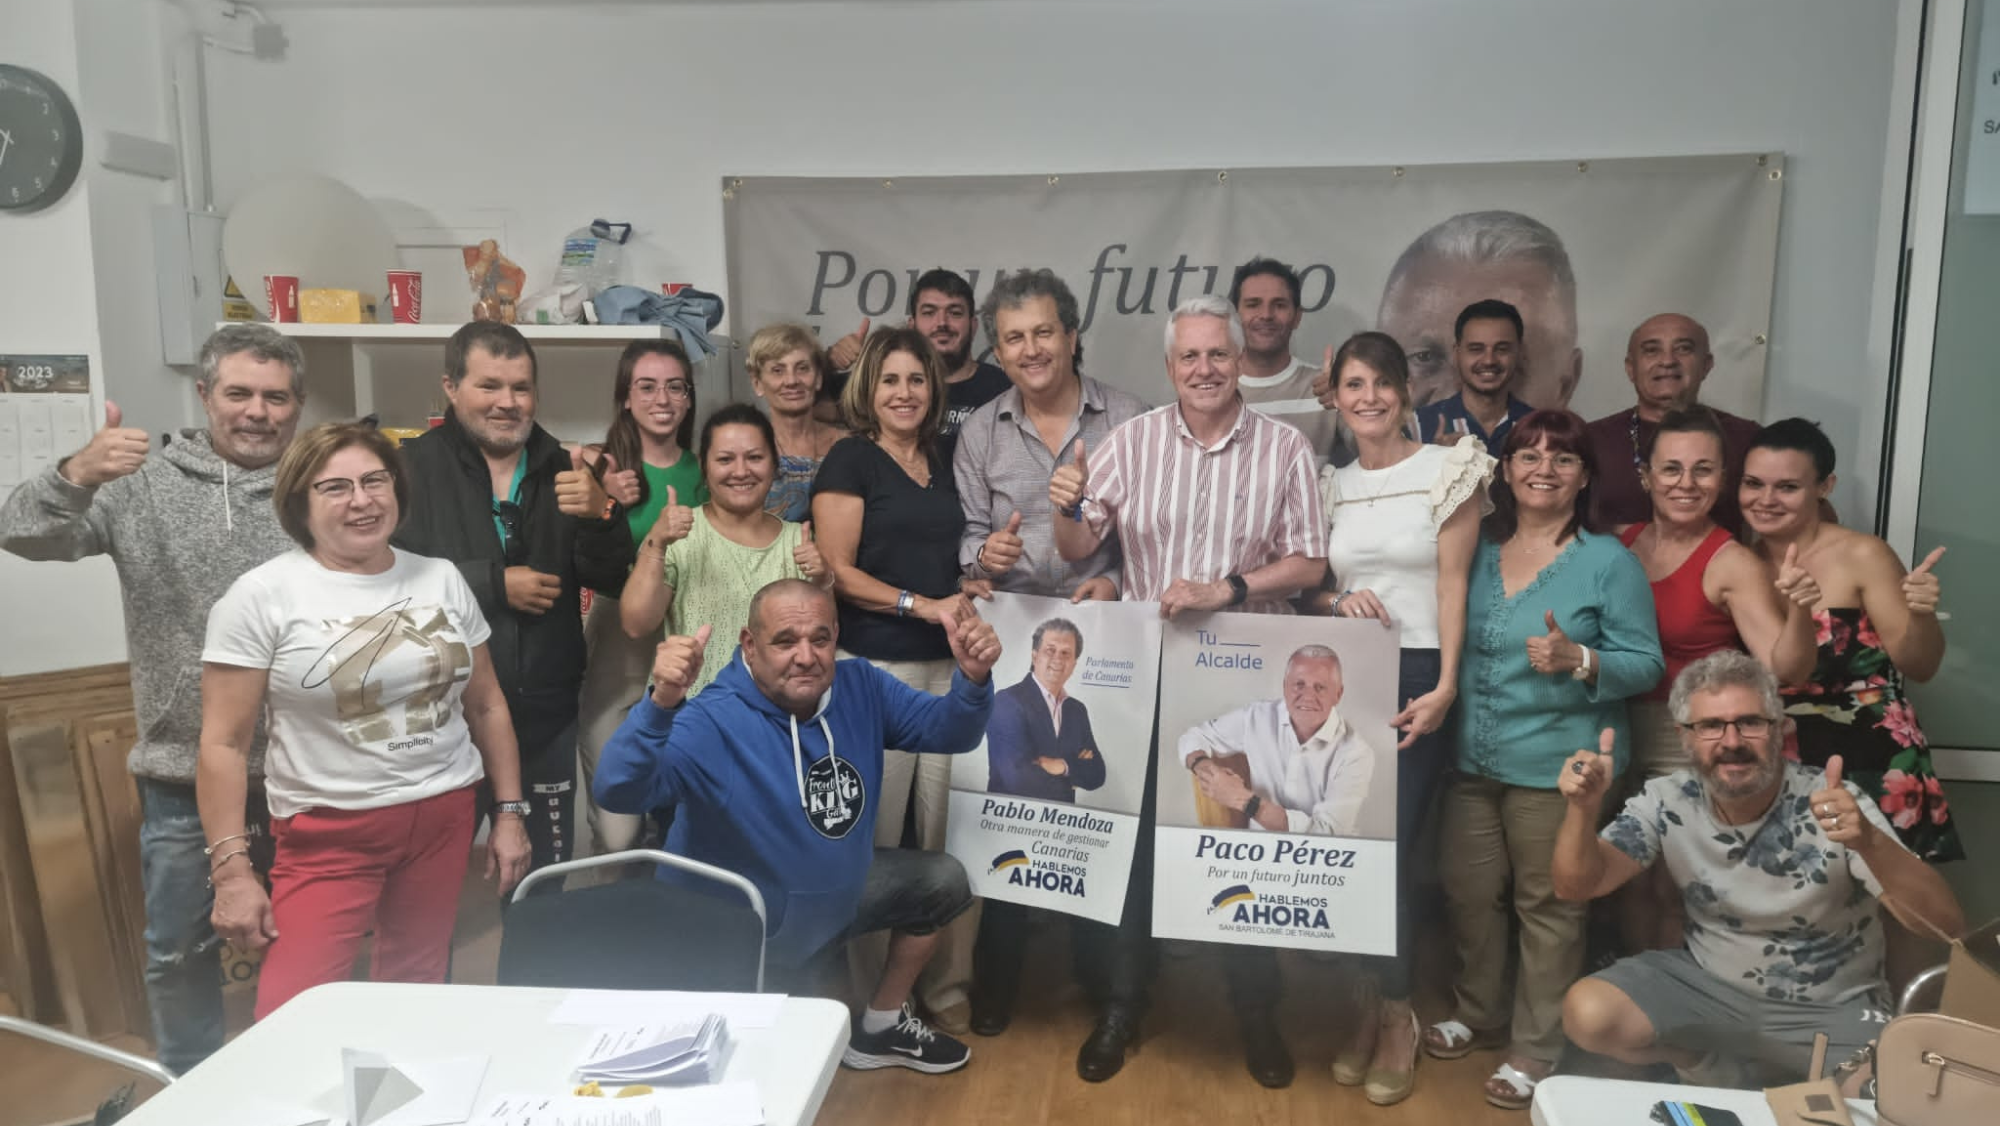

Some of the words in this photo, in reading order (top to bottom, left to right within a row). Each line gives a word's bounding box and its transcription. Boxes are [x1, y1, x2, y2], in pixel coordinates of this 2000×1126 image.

[18, 366, 54, 379] 2023
[1196, 630, 1217, 645] Tu
[1086, 656, 1134, 670] Parlamento
[1195, 652, 1263, 670] Alcalde
[1082, 670, 1094, 680] de
[1095, 671, 1132, 683] Canarias
[388, 736, 434, 751] Simplicity
[981, 799, 1036, 822] Pablo
[1039, 806, 1114, 834] Mendoza
[980, 819, 1004, 832] Otra
[1006, 824, 1050, 839] manera
[1052, 828, 1066, 840] de
[1066, 833, 1110, 848] gestionar
[1031, 840, 1090, 863] Canarias
[1195, 834, 1265, 862] Paco
[1272, 840, 1357, 868] Pérez
[1032, 859, 1087, 877] HABLEMOS
[1207, 866, 1230, 878] Por
[1232, 870, 1248, 880] un
[1249, 869, 1291, 883] futuro
[1292, 869, 1346, 887] juntos
[1008, 866, 1086, 897] AHORA
[1259, 893, 1328, 908] HABLEMOS
[1232, 903, 1330, 930] AHORA
[1218, 923, 1235, 932] SAN
[1285, 928, 1298, 937] DE
[1298, 929, 1336, 939] TIRAJANA
